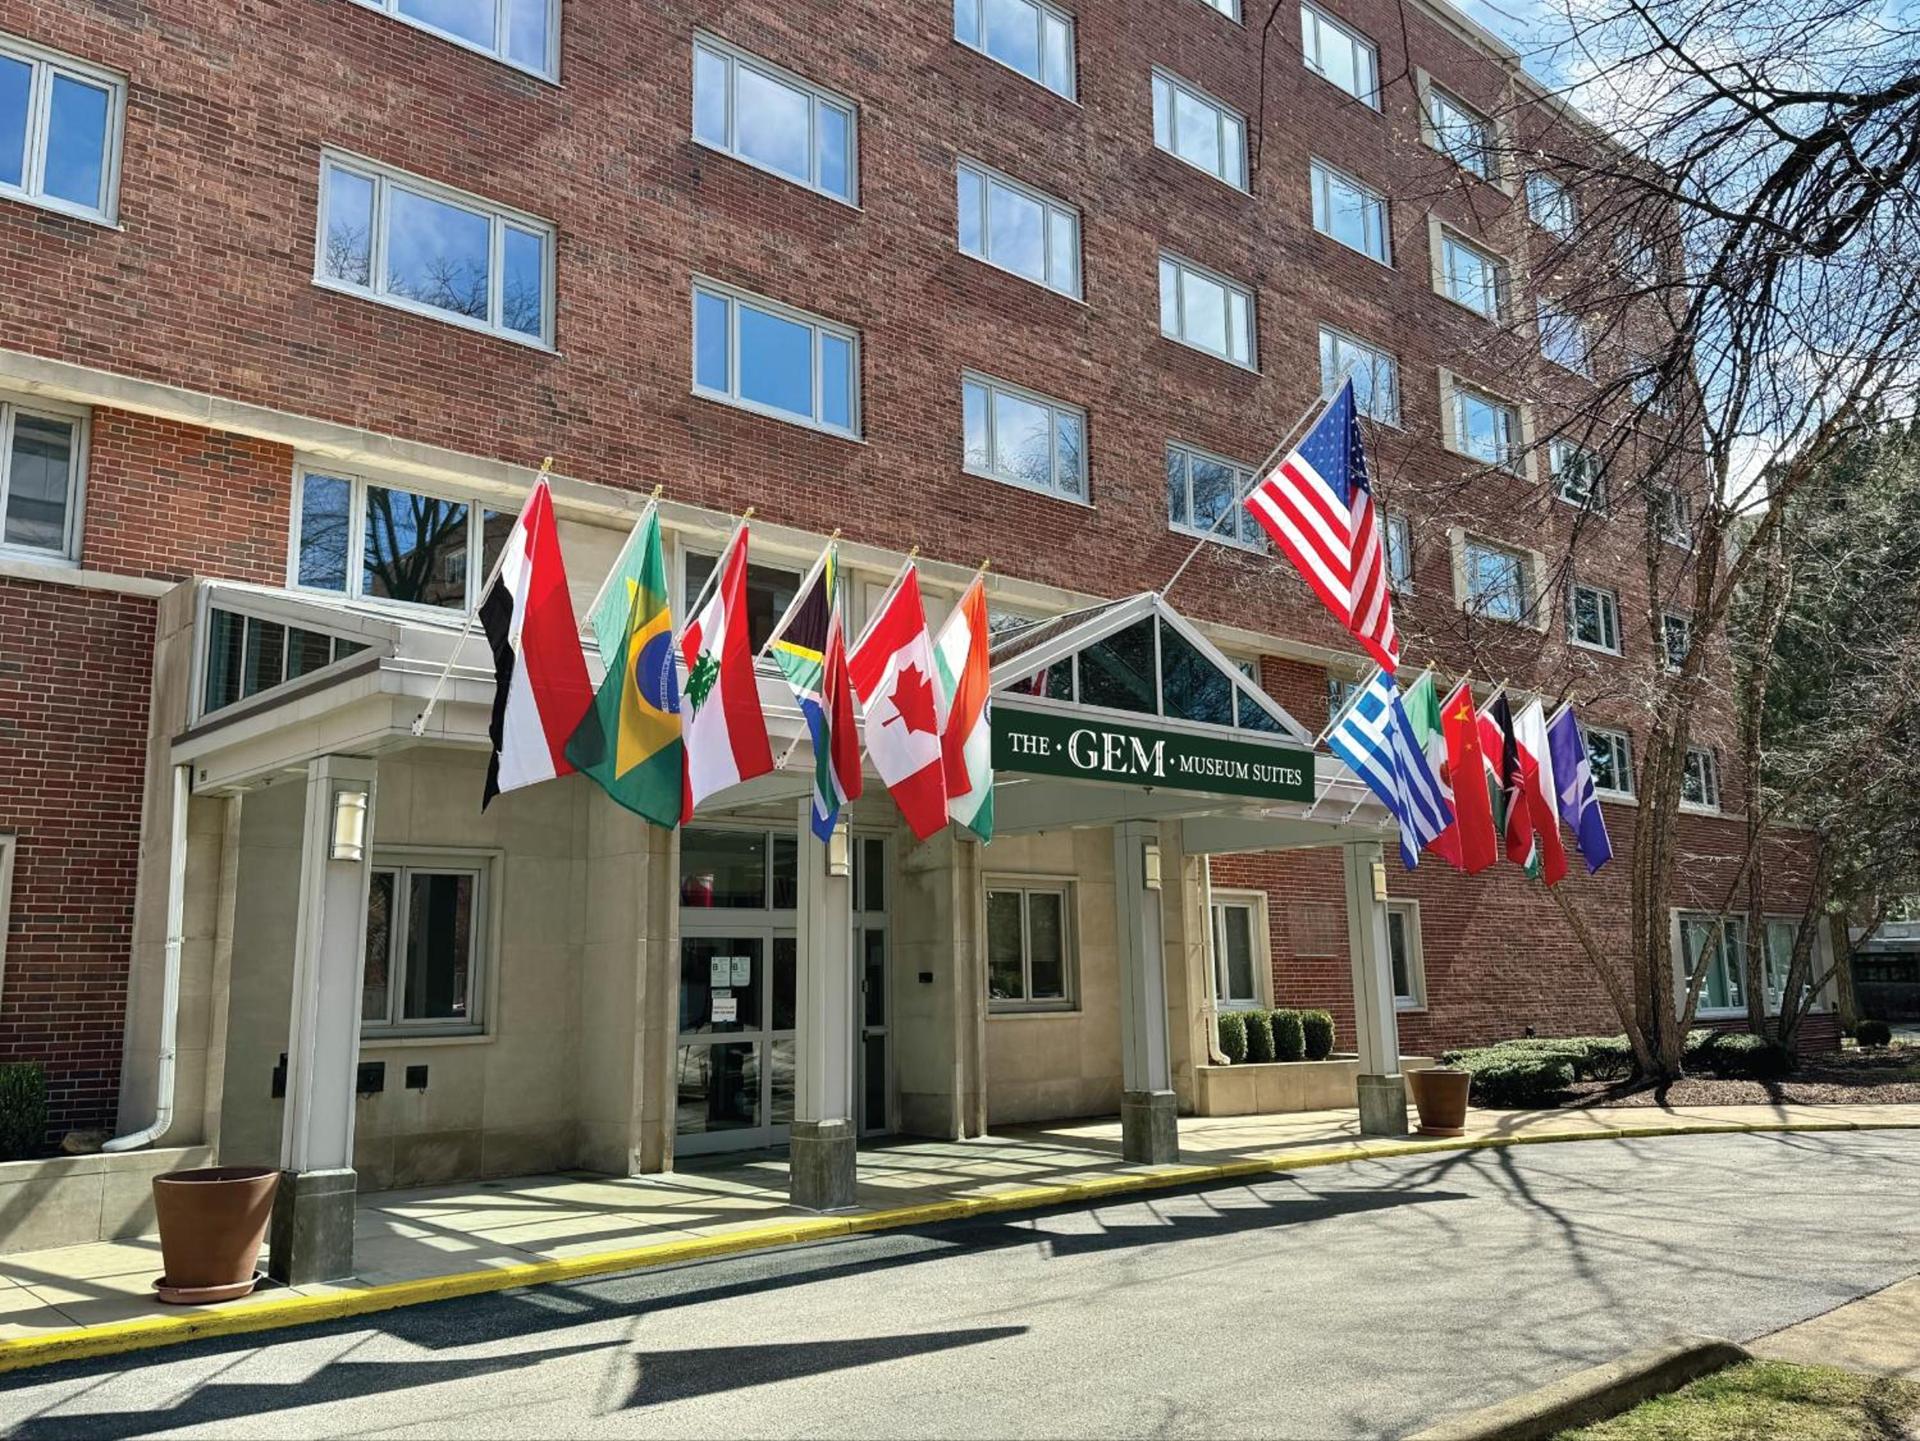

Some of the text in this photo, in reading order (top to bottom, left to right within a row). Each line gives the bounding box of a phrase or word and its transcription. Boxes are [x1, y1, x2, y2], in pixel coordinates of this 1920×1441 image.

[1008, 729, 1302, 786] THE GEM MUSEUM SUITES
